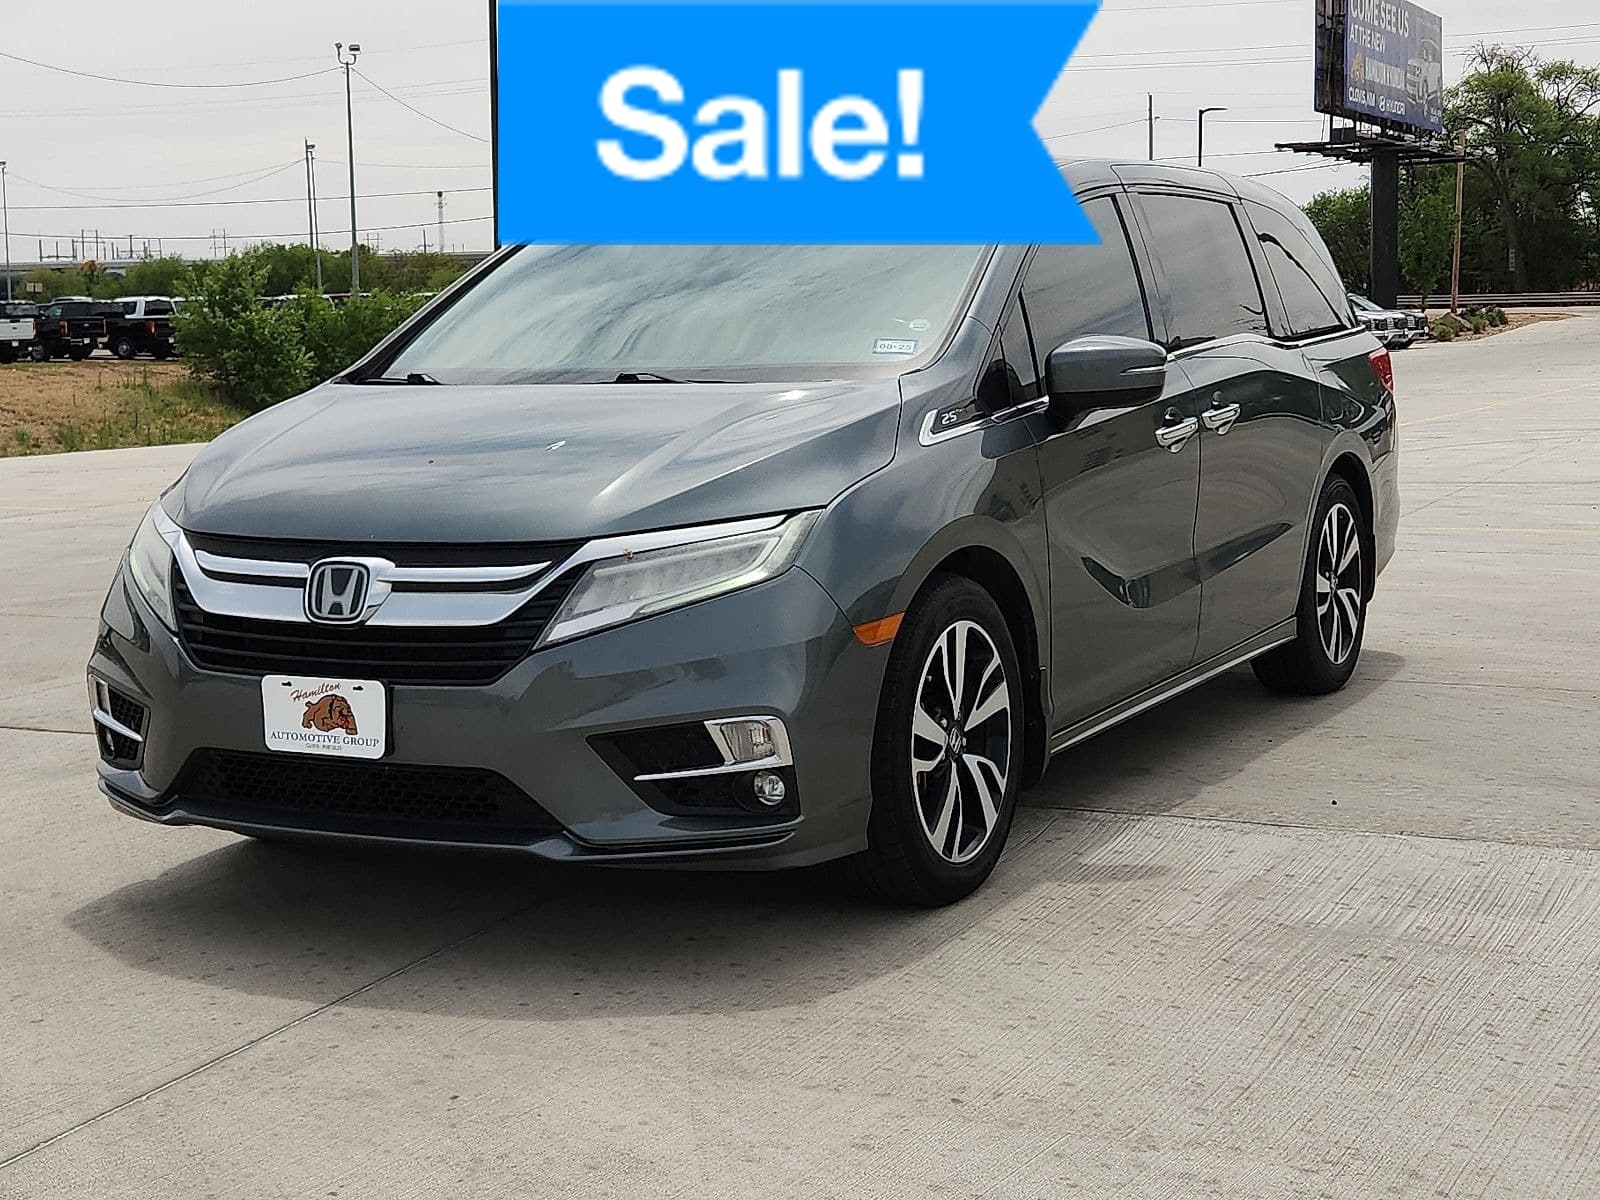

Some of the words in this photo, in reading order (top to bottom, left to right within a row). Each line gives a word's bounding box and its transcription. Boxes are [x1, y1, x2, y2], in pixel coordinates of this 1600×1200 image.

[1350, 0, 1379, 26] COME
[1380, 0, 1397, 34] SEE
[1398, 8, 1409, 38] US
[1349, 23, 1358, 43] AT
[1359, 26, 1371, 48] THE
[1371, 30, 1386, 53] NEW
[290, 682, 342, 702] Hamilton
[271, 731, 340, 745] AUTOMOTIVE
[343, 736, 379, 748] GROUP
